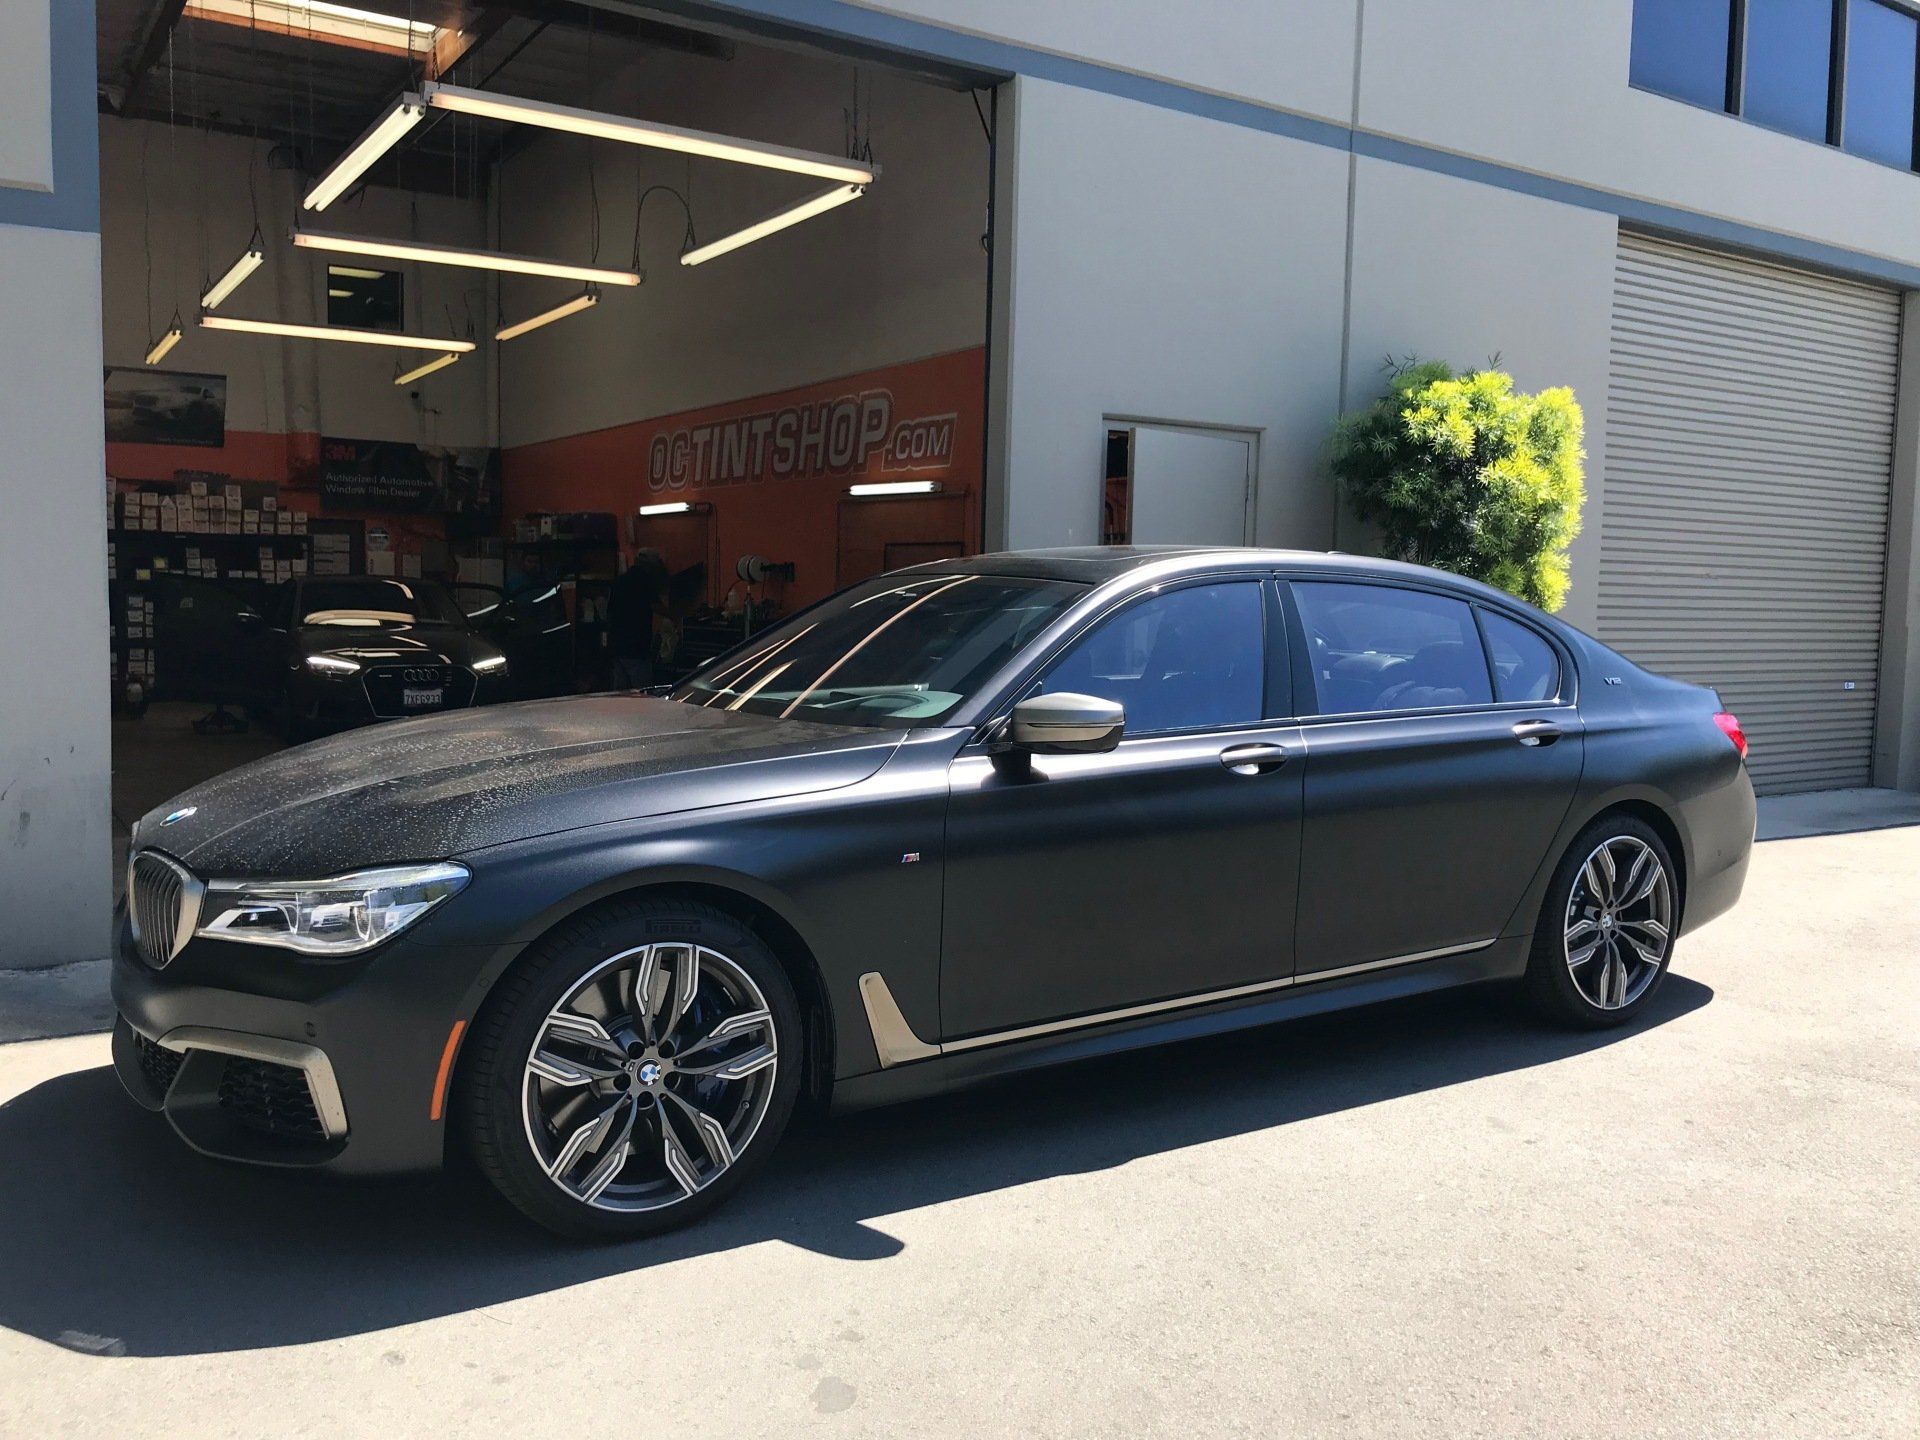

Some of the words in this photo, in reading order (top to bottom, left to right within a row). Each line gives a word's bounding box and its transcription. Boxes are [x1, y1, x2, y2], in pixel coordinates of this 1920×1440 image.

[326, 444, 356, 460] 3M
[326, 472, 377, 484] Authorized
[379, 475, 434, 487] Automotive
[326, 483, 365, 495] Window
[368, 485, 388, 496] Film
[390, 486, 421, 498] Dealer
[1604, 677, 1622, 685] V12
